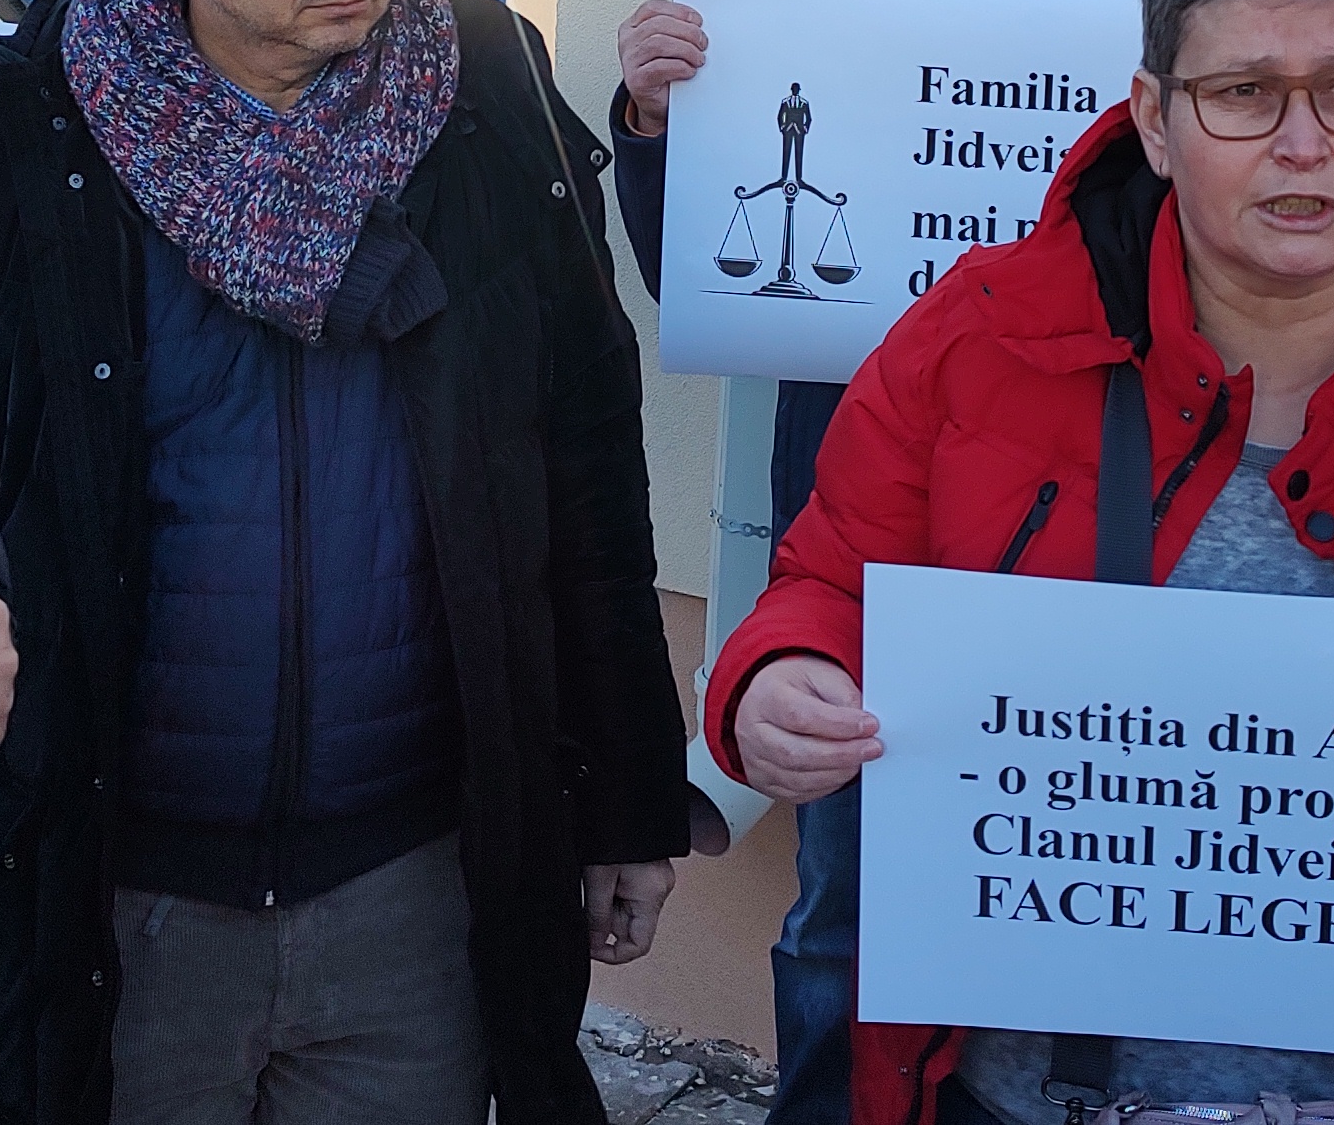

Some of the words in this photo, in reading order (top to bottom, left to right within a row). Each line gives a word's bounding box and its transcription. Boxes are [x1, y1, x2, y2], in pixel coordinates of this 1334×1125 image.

[916, 65, 1100, 115] Familia
[910, 205, 998, 245] mai
[980, 694, 1187, 756] Justiția
[1208, 713, 1296, 757] din
[998, 766, 1026, 796] o
[1047, 761, 1219, 812] glumă
[971, 812, 1157, 867] Clanul
[973, 875, 1148, 930] FACE
